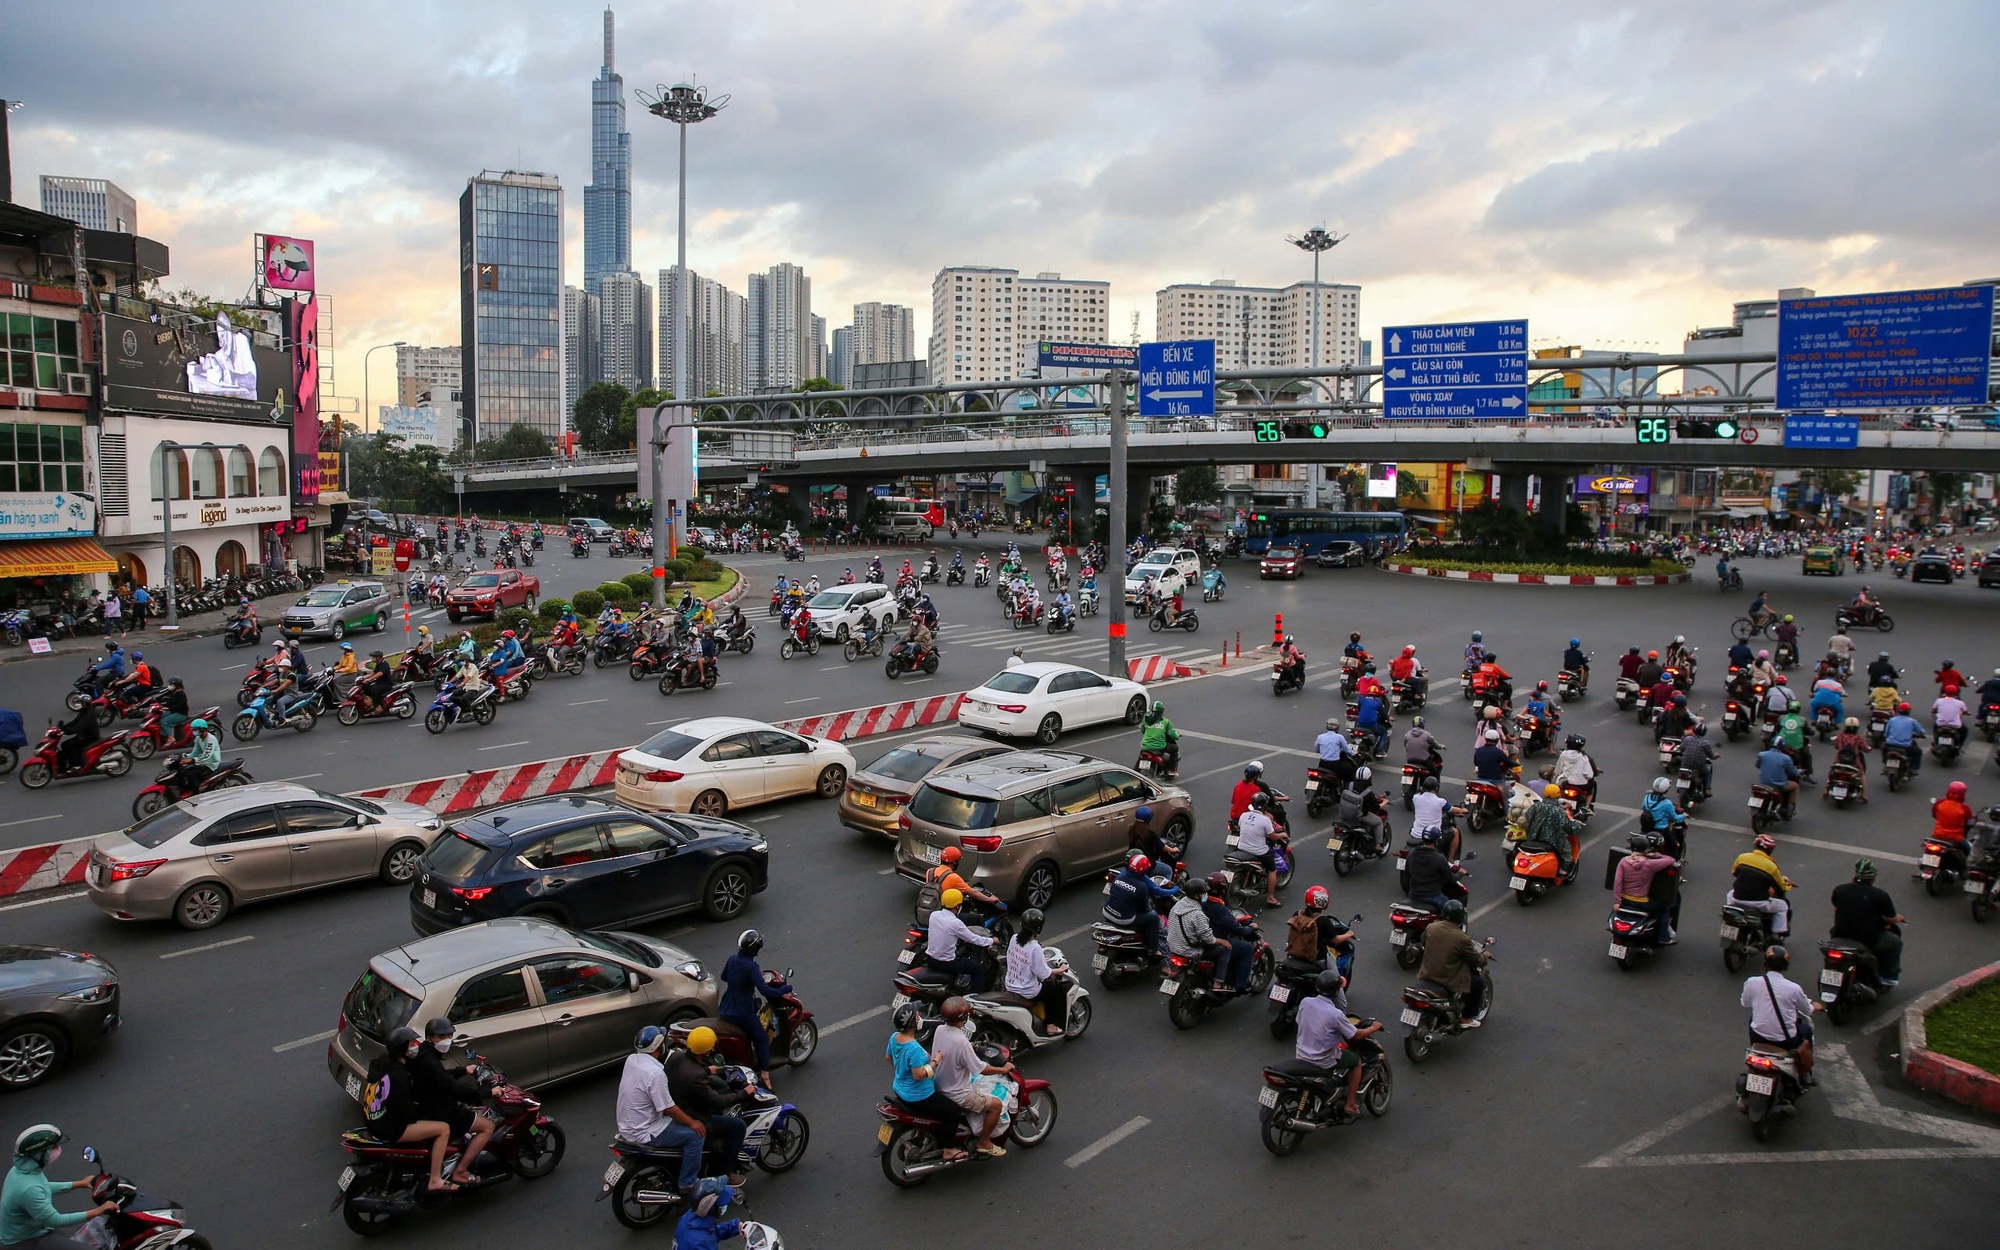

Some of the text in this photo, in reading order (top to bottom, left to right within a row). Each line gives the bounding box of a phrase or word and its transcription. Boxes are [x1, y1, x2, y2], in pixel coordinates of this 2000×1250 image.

[1412, 328, 1433, 340] THẢO
[1456, 326, 1475, 337] VIÊN
[1510, 326, 1522, 334] Km
[1163, 343, 1194, 362] BẾN XE
[1412, 344, 1428, 353] CHỢ
[1430, 344, 1442, 353] THỊ
[1446, 340, 1466, 351] NGHÈ
[1510, 340, 1522, 349] Km
[1412, 358, 1428, 370] CẦU
[1430, 359, 1443, 370] SÀI
[1446, 358, 1463, 369] GÒN
[1511, 359, 1523, 367] Km
[1142, 365, 1210, 386] MIỀN ĐÔNG MỚI
[1412, 374, 1429, 384] NGÃ
[1431, 374, 1443, 384] TƯ
[1444, 372, 1460, 383] THỦ
[1463, 372, 1480, 383] ĐỨC
[1511, 373, 1522, 381] Km
[1410, 391, 1454, 401] VÒNG XOAY
[1168, 402, 1190, 414] 16 Km
[1488, 398, 1500, 407] Km
[1448, 403, 1474, 415] KHIÊM
[409, 432, 433, 441] Finhay
[1258, 422, 1278, 441] 26
[1638, 419, 1667, 442] 26
[14, 511, 36, 526] hàng
[39, 513, 59, 524] xanh
